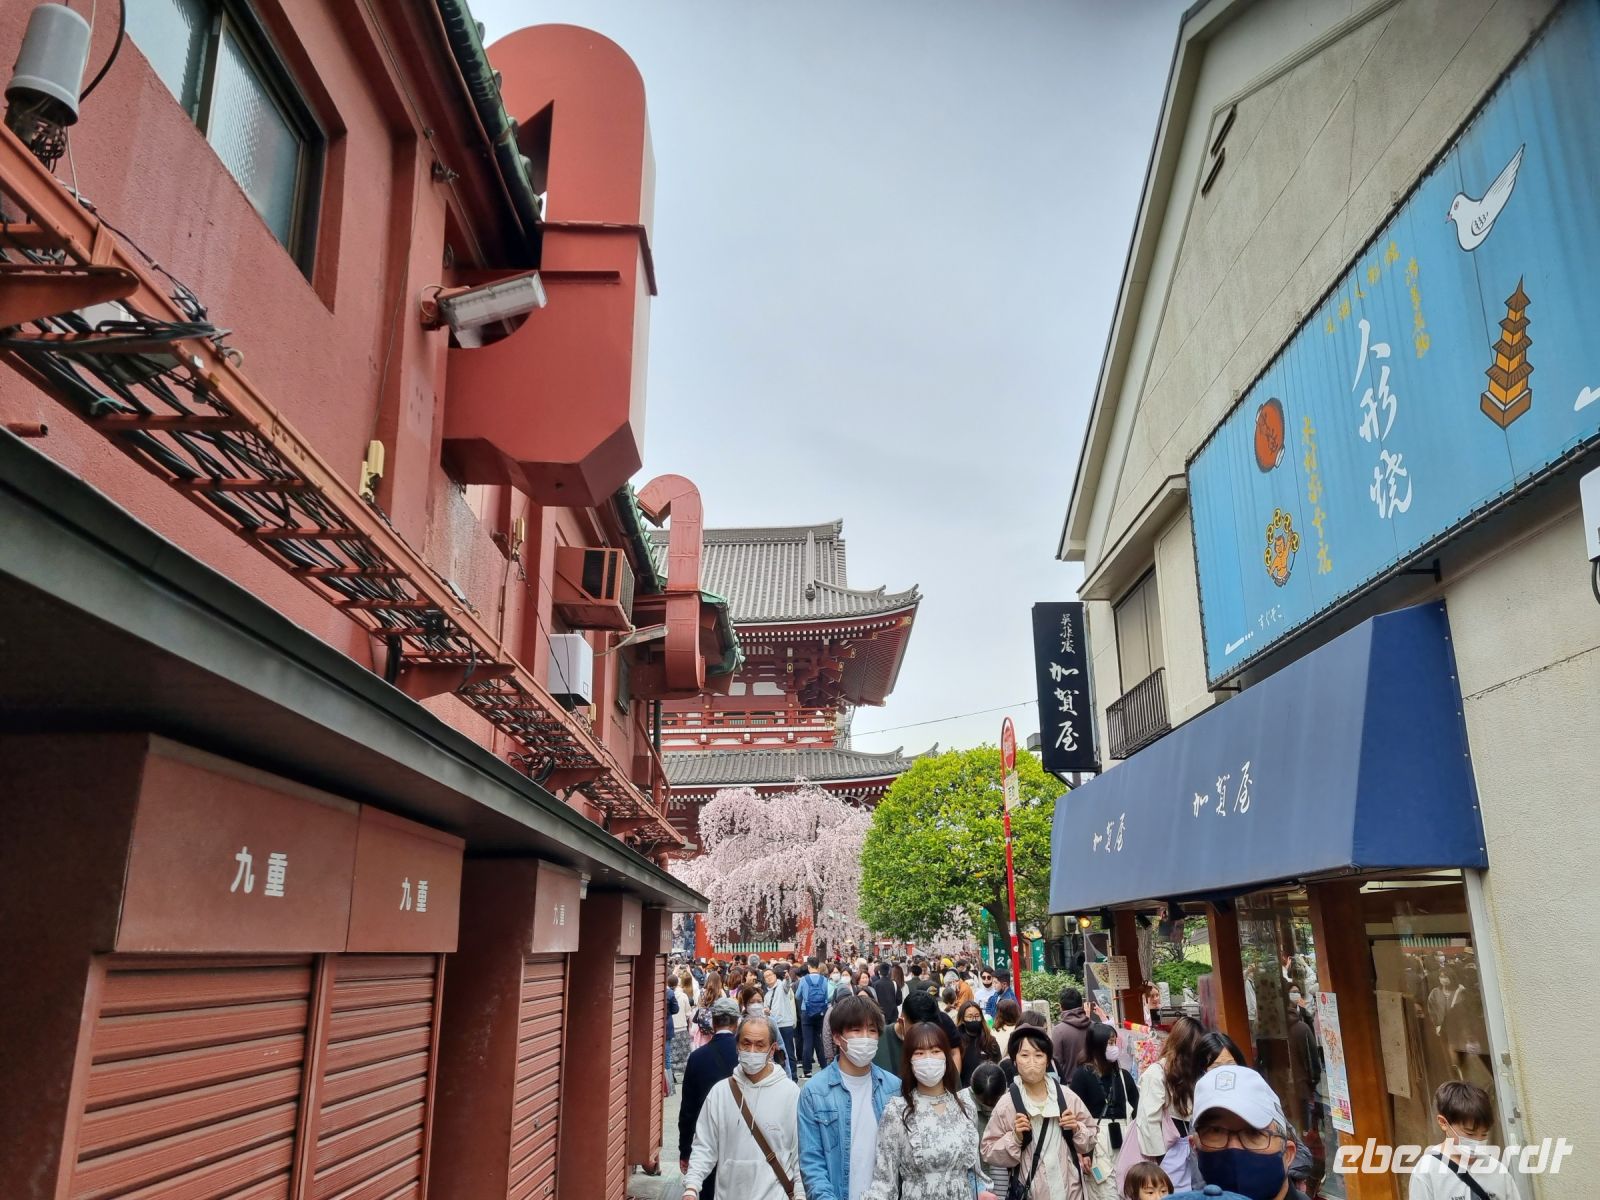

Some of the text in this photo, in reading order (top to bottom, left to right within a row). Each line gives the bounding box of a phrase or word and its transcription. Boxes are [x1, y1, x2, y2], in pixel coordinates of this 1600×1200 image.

[1352, 318, 1413, 519] 人形焼
[1049, 661, 1080, 752] 加賀屋
[1193, 760, 1253, 818] 加賀屋
[1092, 811, 1126, 854] 加賀屋
[230, 846, 288, 897] 九重
[400, 877, 429, 913] 九重
